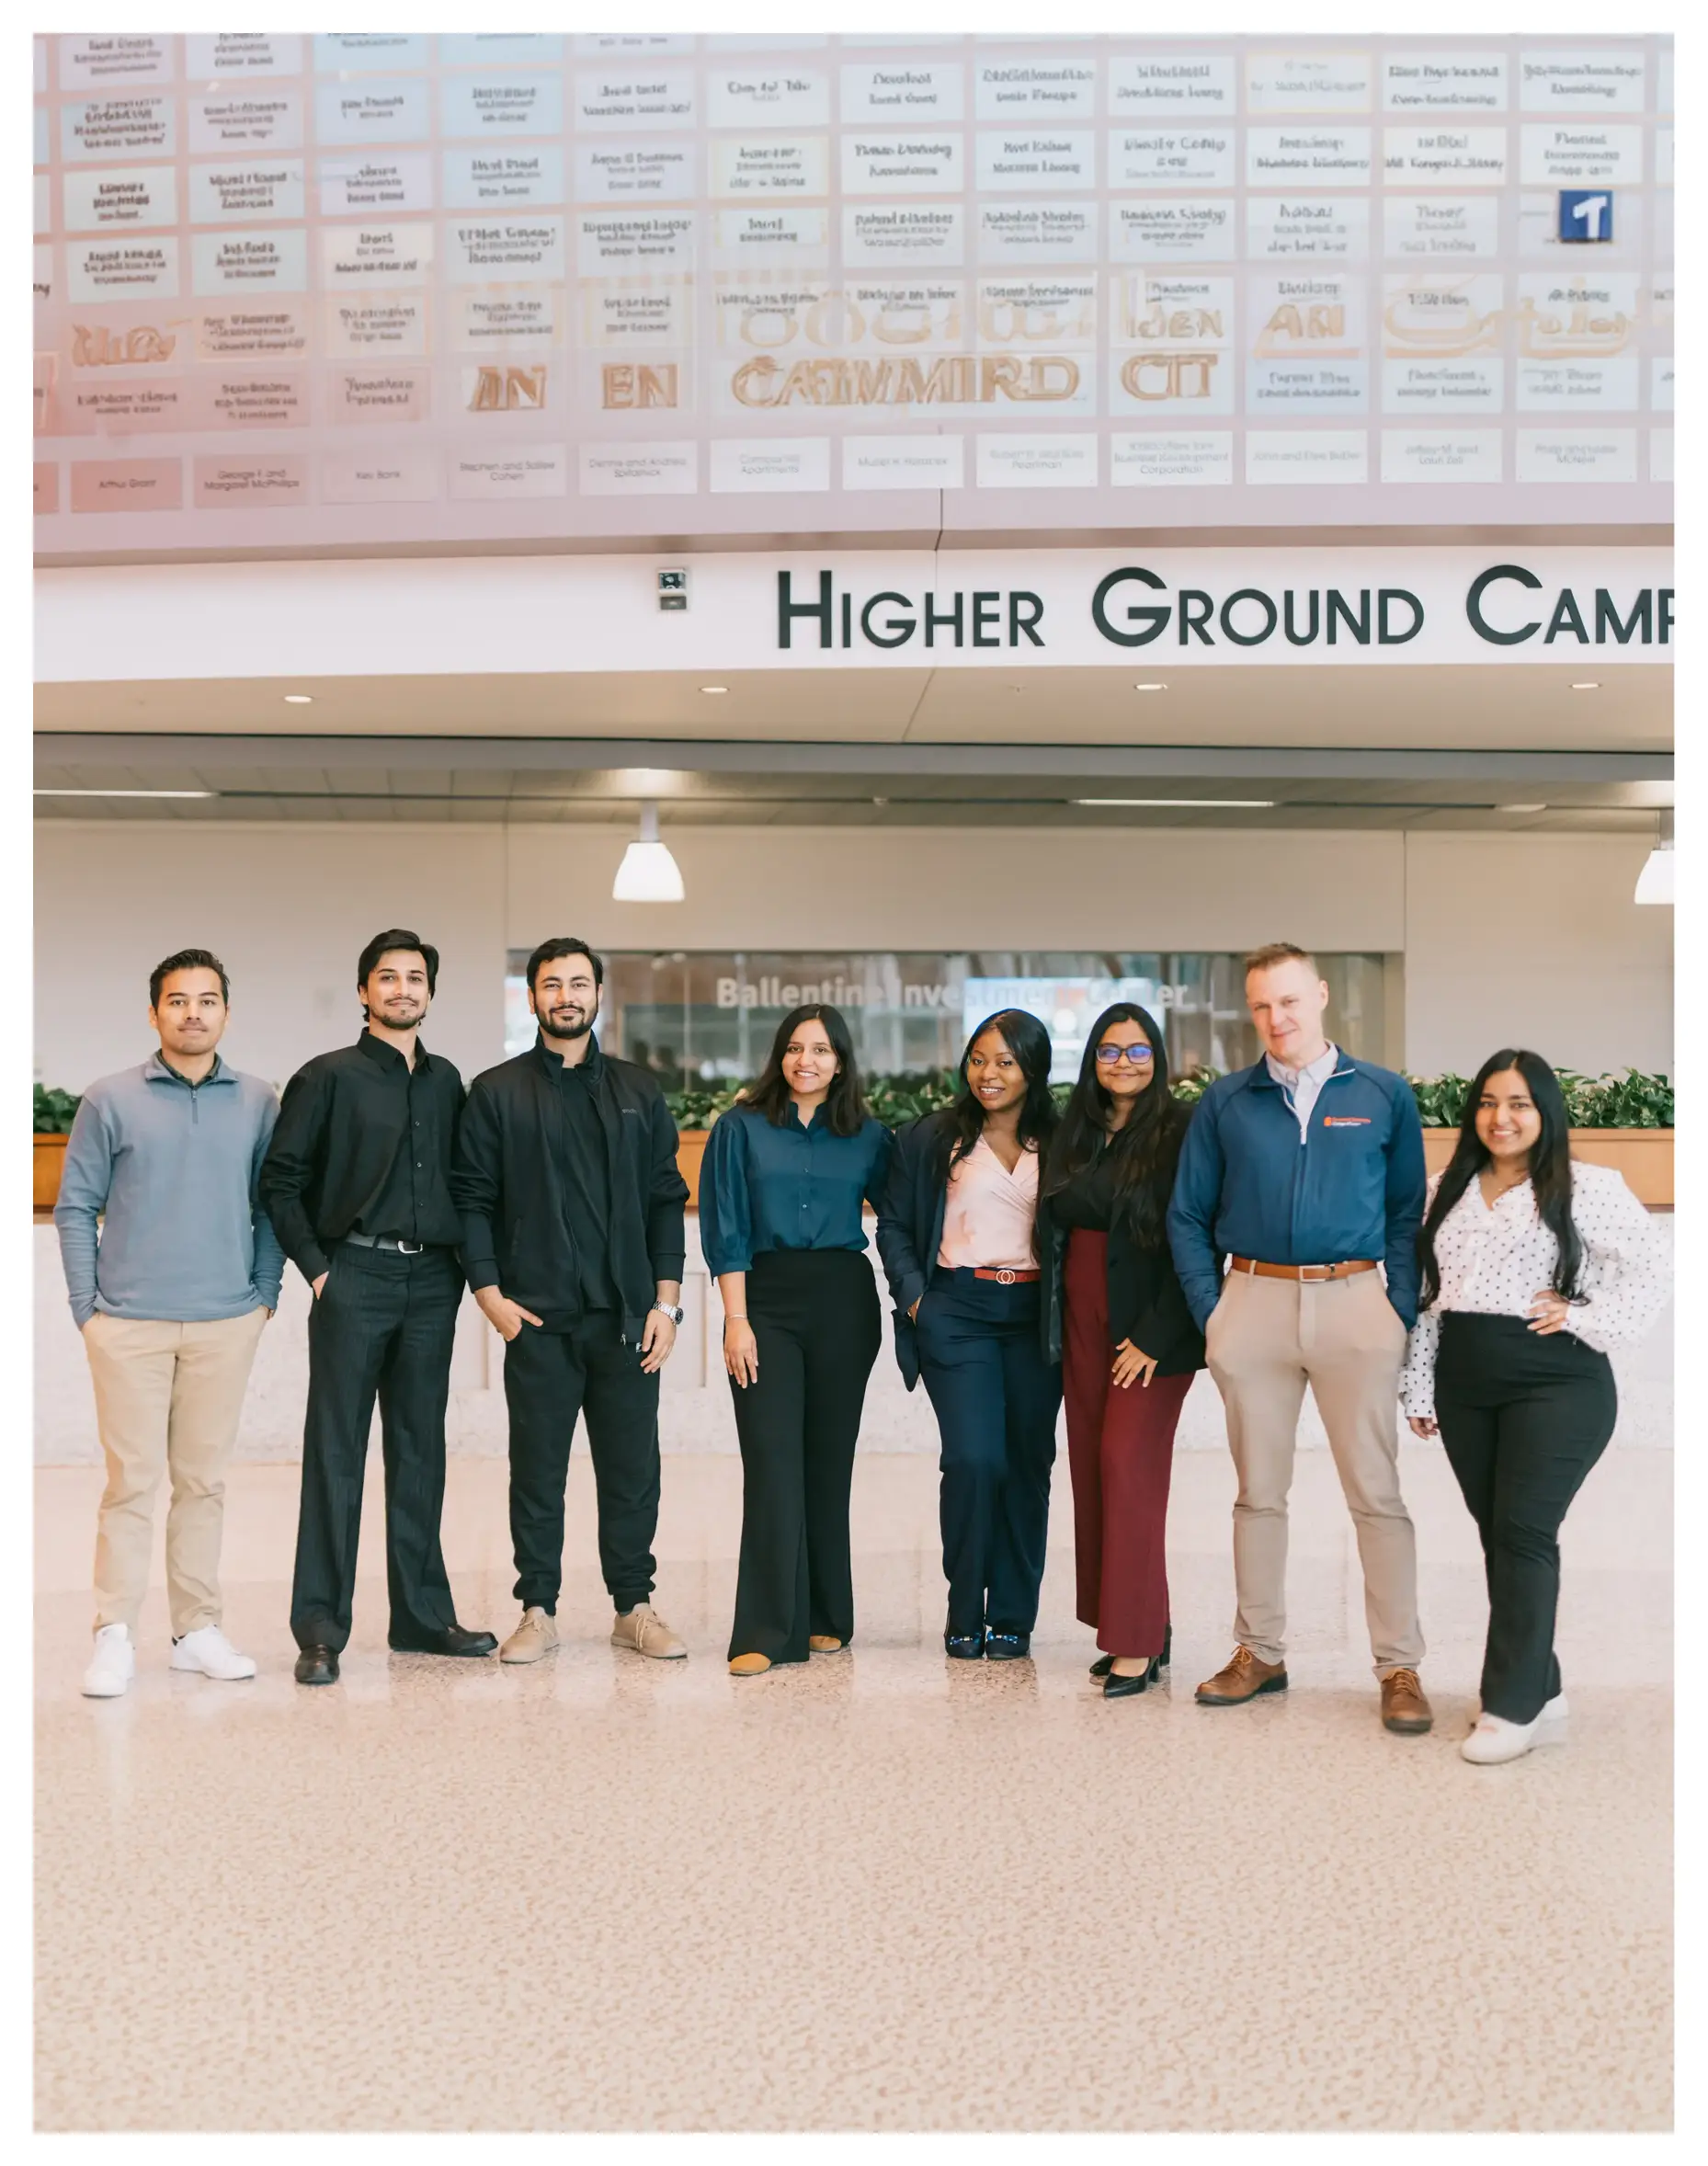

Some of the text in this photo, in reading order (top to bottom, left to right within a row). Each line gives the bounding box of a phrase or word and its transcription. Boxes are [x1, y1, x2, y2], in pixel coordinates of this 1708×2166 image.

[741, 464, 800, 476] Apartments
[1140, 463, 1203, 475] Corporation
[490, 471, 525, 482] Cohen
[777, 570, 1046, 649] HIGHER
[1091, 565, 1425, 647] GROUND
[716, 976, 883, 1009] Ballentine
[1087, 975, 1189, 1009] Ceer
